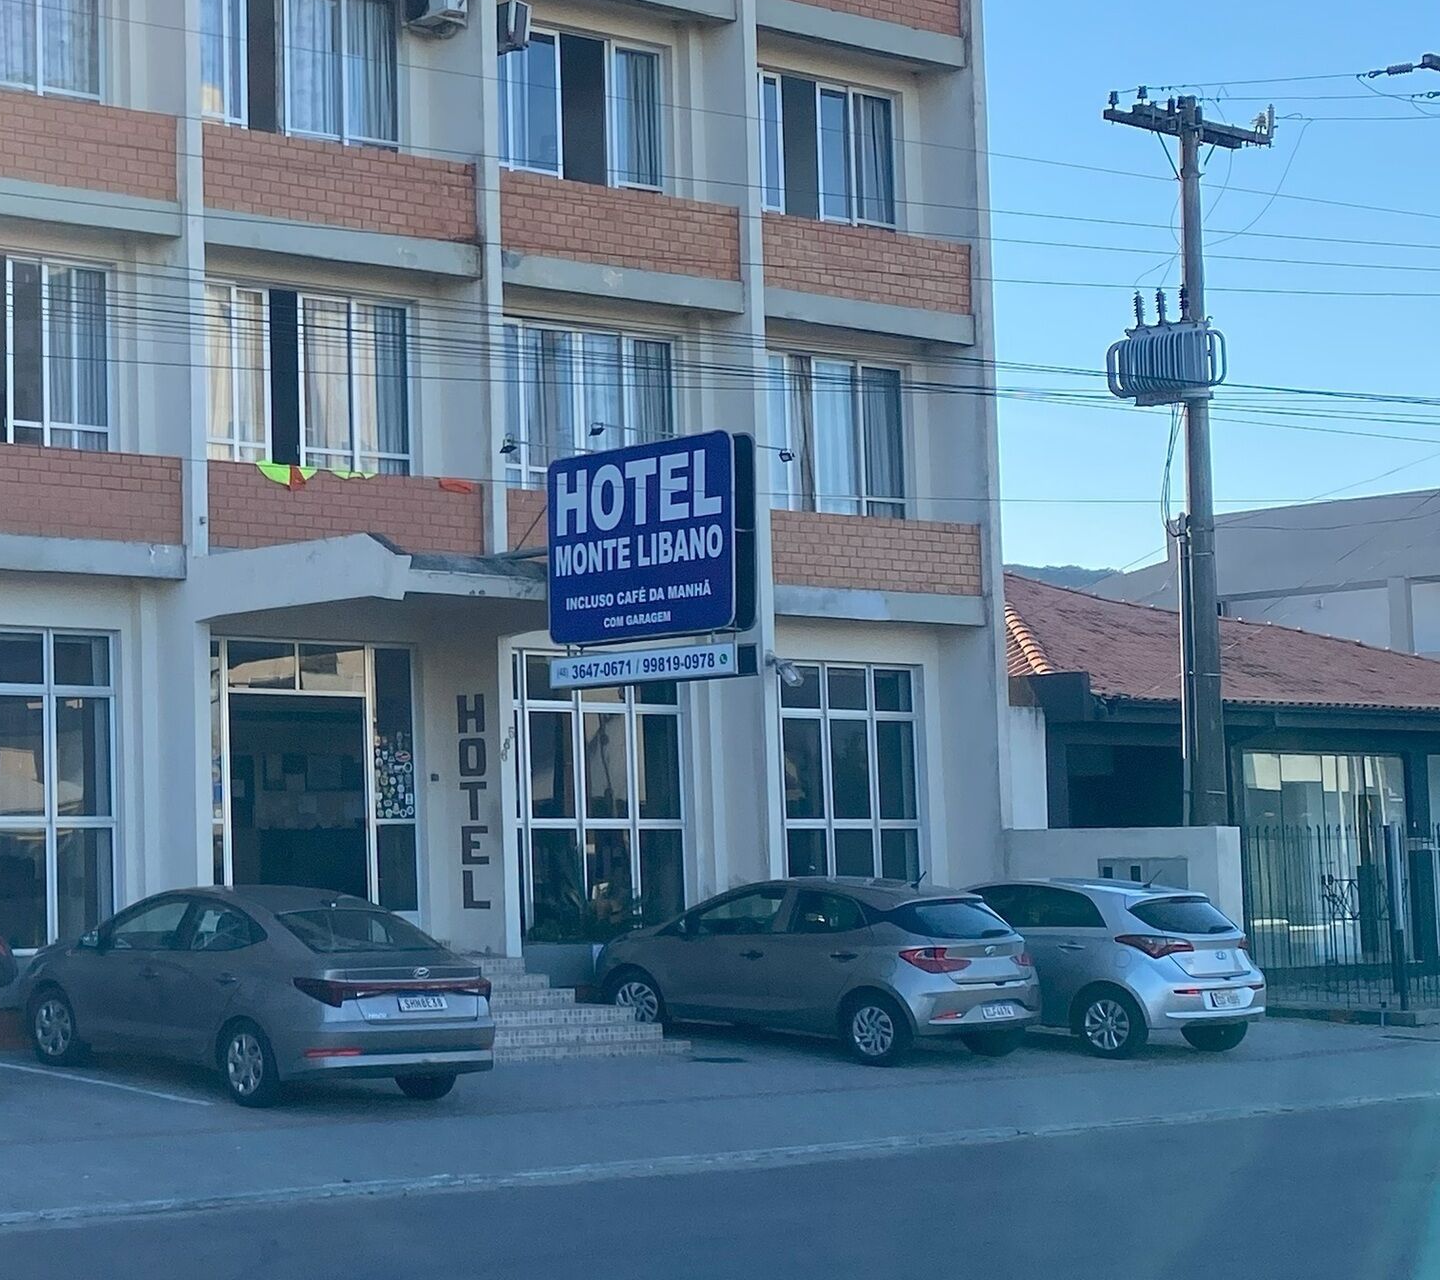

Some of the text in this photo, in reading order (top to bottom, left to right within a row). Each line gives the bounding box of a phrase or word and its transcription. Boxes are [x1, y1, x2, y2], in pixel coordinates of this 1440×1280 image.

[556, 449, 722, 537] HOTEL
[555, 524, 723, 577] MONTE LIBANO
[566, 579, 712, 611] INCLUSO CAFÉ DA MANHÃ
[603, 610, 671, 628] COM GARAGEM
[572, 660, 632, 680] 3647-0671
[642, 653, 715, 673] 99819-0978
[456, 693, 491, 910] HOTEL
